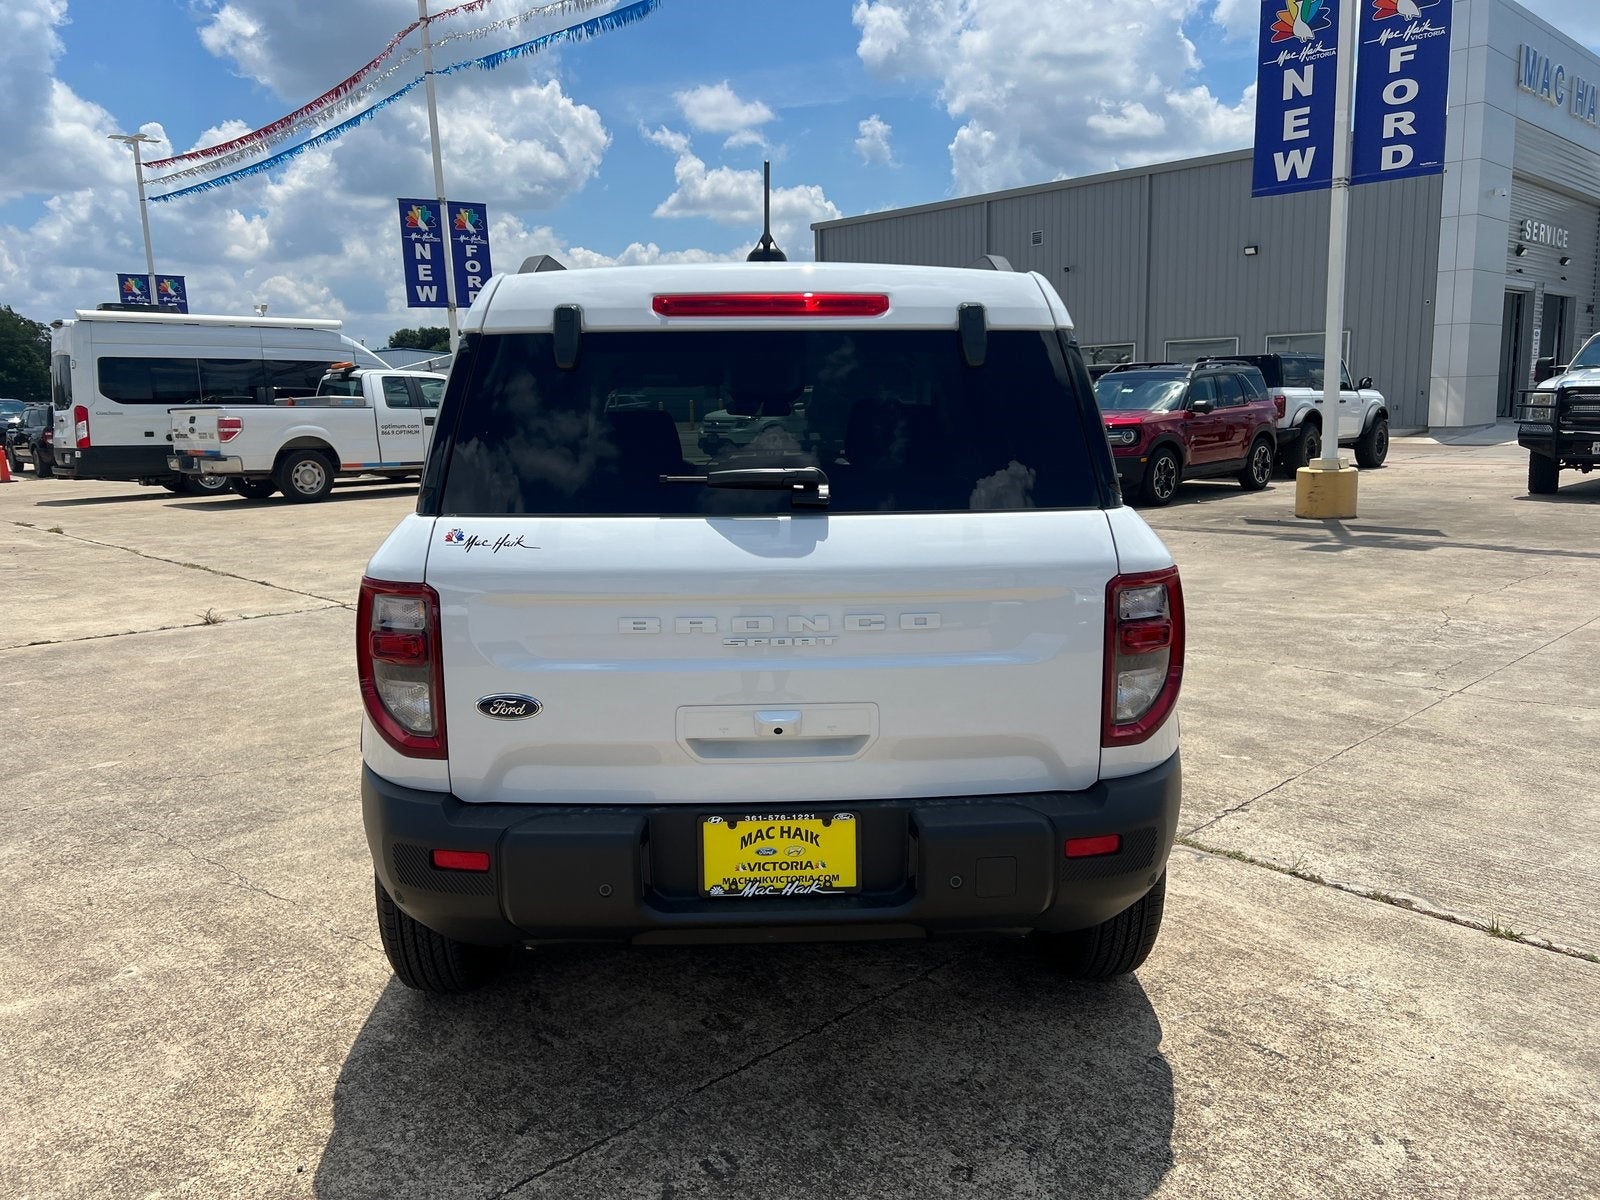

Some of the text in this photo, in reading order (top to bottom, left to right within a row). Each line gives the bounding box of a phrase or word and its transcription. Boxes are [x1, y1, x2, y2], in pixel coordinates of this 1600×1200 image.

[1378, 19, 1437, 46] Mac Haik
[1410, 29, 1446, 41] VICTORIA
[1276, 40, 1331, 67] Mac Haik
[1305, 50, 1337, 62] VICTORIA
[1519, 43, 1600, 128] MAC HA
[1381, 44, 1419, 172] FORD
[1273, 64, 1316, 182] NEW
[1524, 219, 1569, 249] SERVICE
[414, 243, 438, 302] NEW
[464, 533, 537, 554] Mac Haik
[618, 612, 942, 635] BRONCO
[722, 635, 840, 647] SPORT
[489, 699, 527, 715] Ford
[744, 813, 816, 821] 361-576-1221
[740, 825, 821, 850] MAC HAIK
[747, 860, 815, 872] VICTORIA
[740, 880, 826, 897] Mac Haik
